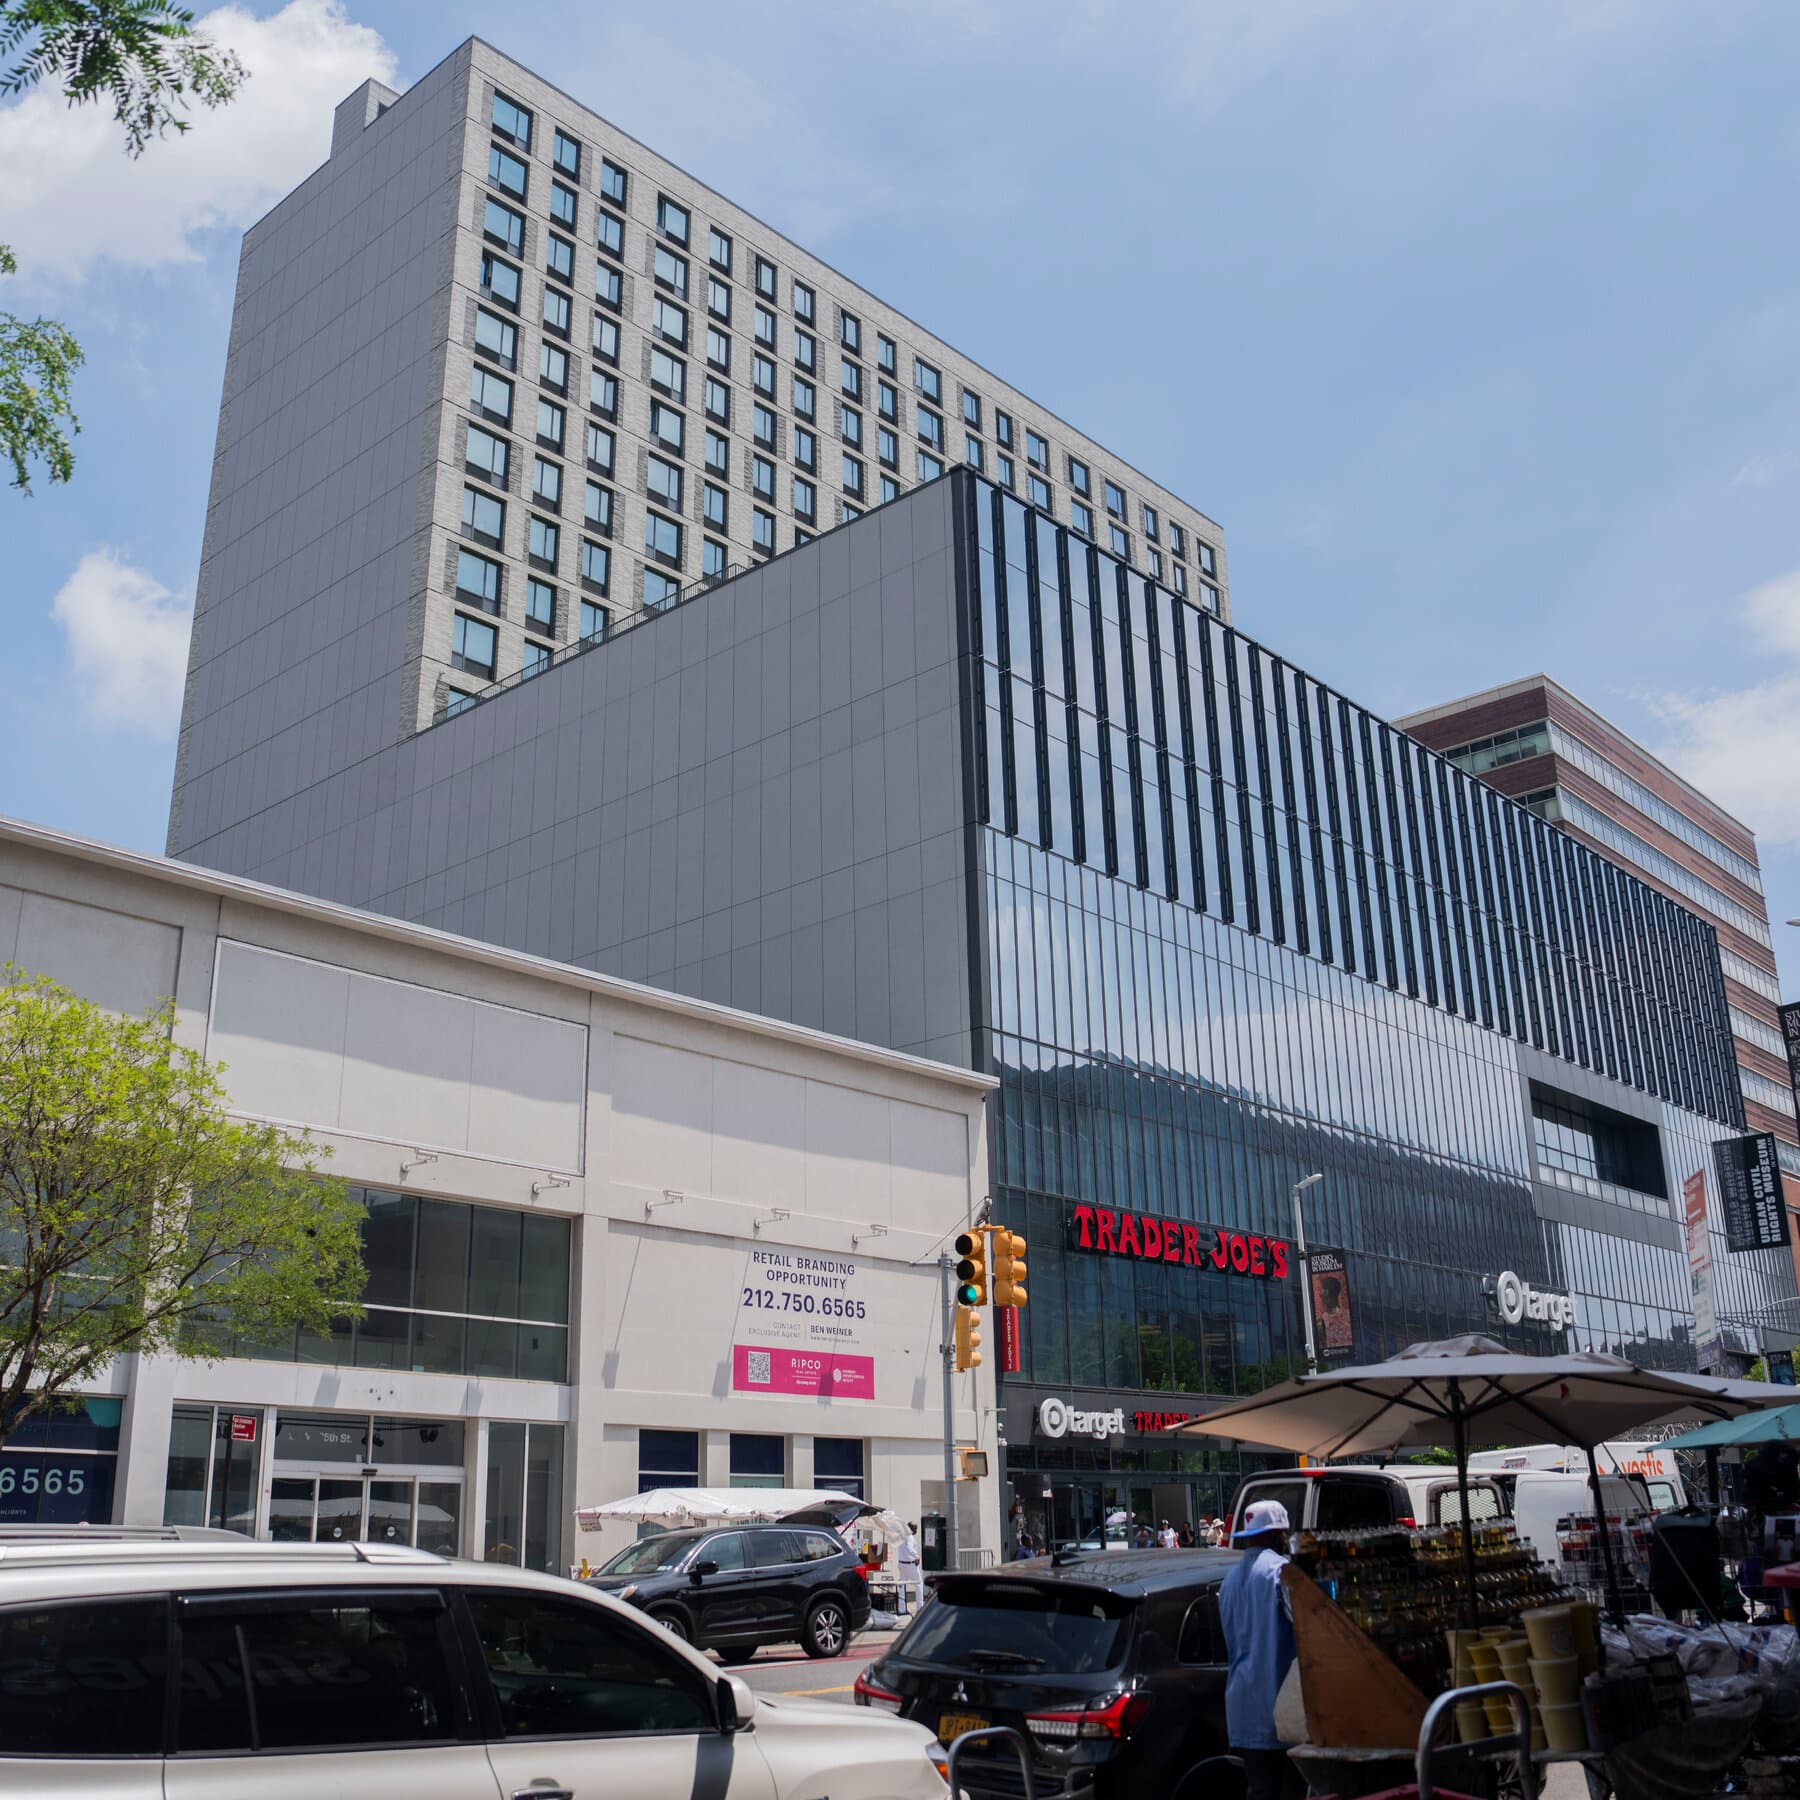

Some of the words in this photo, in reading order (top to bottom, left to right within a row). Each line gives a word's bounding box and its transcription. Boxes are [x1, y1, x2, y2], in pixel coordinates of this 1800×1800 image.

[1750, 1164, 1764, 1199] CIVIL
[1757, 1138, 1774, 1193] MUSEUM
[1755, 1201, 1771, 1244] URBAN
[1766, 1195, 1782, 1242] RIGHTS
[1074, 1204, 1201, 1267] TRADER
[1208, 1230, 1288, 1279] JOE'S
[753, 1251, 792, 1268] RETAIL
[796, 1257, 856, 1276] BRANDING
[766, 1269, 847, 1290] OPPORTUNITY
[743, 1287, 866, 1319] 212.750.6565
[1521, 1281, 1577, 1331] target
[810, 1325, 825, 1334] BEN
[826, 1327, 853, 1337] WEINER
[791, 1358, 821, 1370] RIPCO
[1066, 1405, 1126, 1440] target
[0, 1466, 85, 1495] 6565
[1621, 1452, 1665, 1477] vestis
